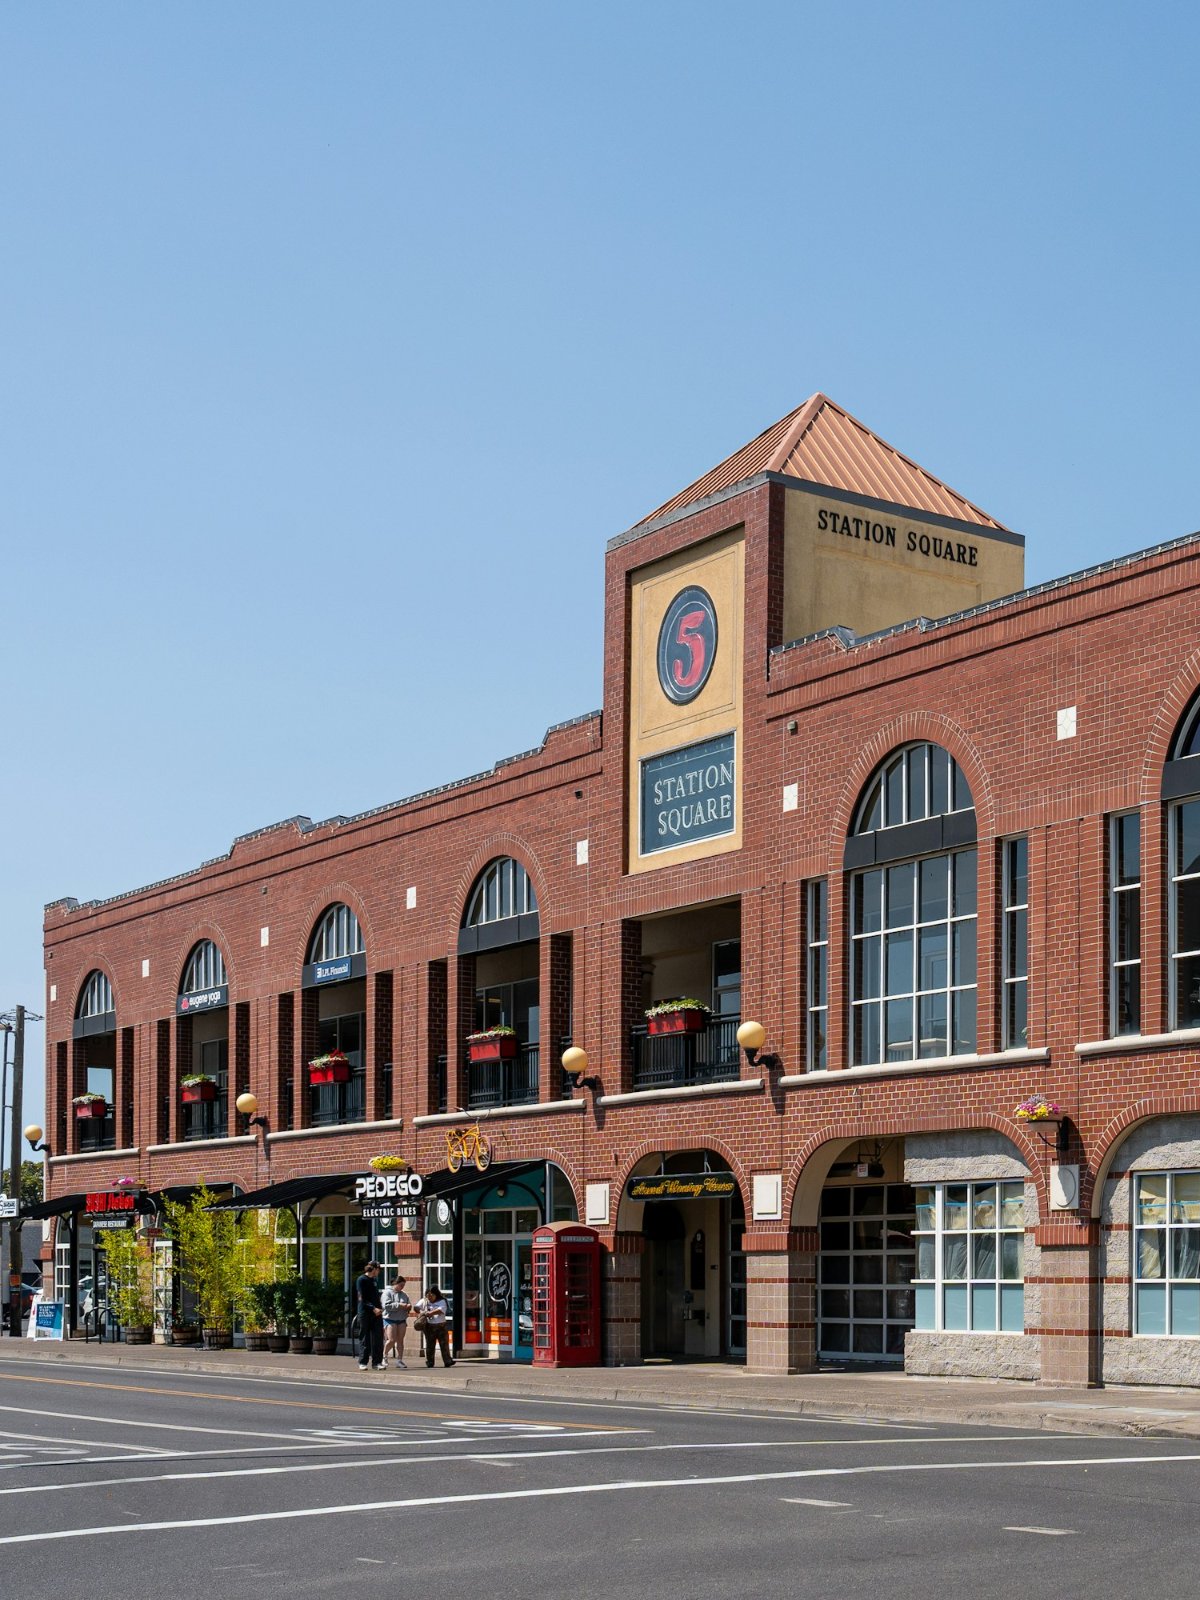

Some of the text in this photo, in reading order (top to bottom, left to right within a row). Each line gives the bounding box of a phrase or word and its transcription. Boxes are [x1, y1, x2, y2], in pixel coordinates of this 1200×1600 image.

[817, 510, 978, 567] STATION SQUARE
[672, 610, 706, 687] 5
[654, 760, 735, 805] STATION
[658, 794, 732, 836] SQUARE
[189, 991, 221, 1008] eugene yoga
[85, 1191, 106, 1213] SUSHI
[355, 1174, 423, 1199] PEDEGO
[362, 1206, 417, 1217] ELECTRIC BIKES
